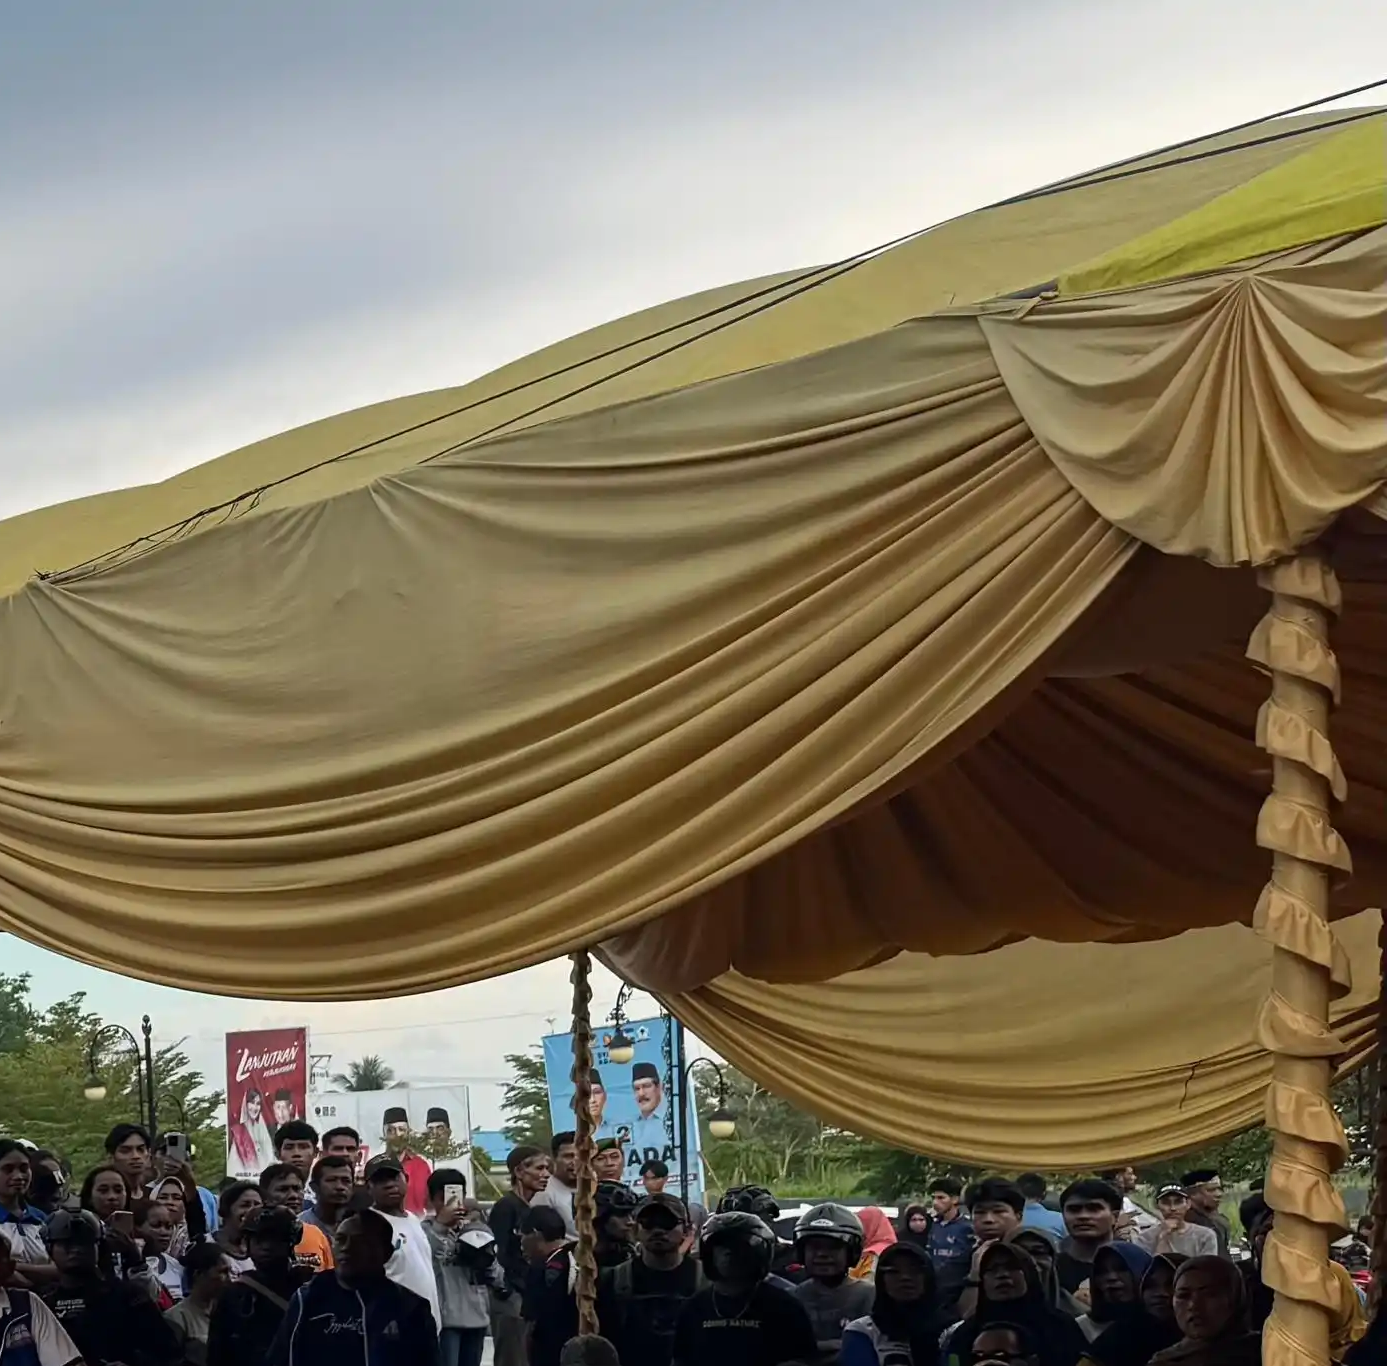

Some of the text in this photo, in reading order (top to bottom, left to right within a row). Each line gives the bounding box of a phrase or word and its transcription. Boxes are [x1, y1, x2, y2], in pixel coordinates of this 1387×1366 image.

[236, 1043, 299, 1082] LANJUTKAN
[616, 1126, 631, 1143] 2
[627, 1144, 677, 1167] ADA
